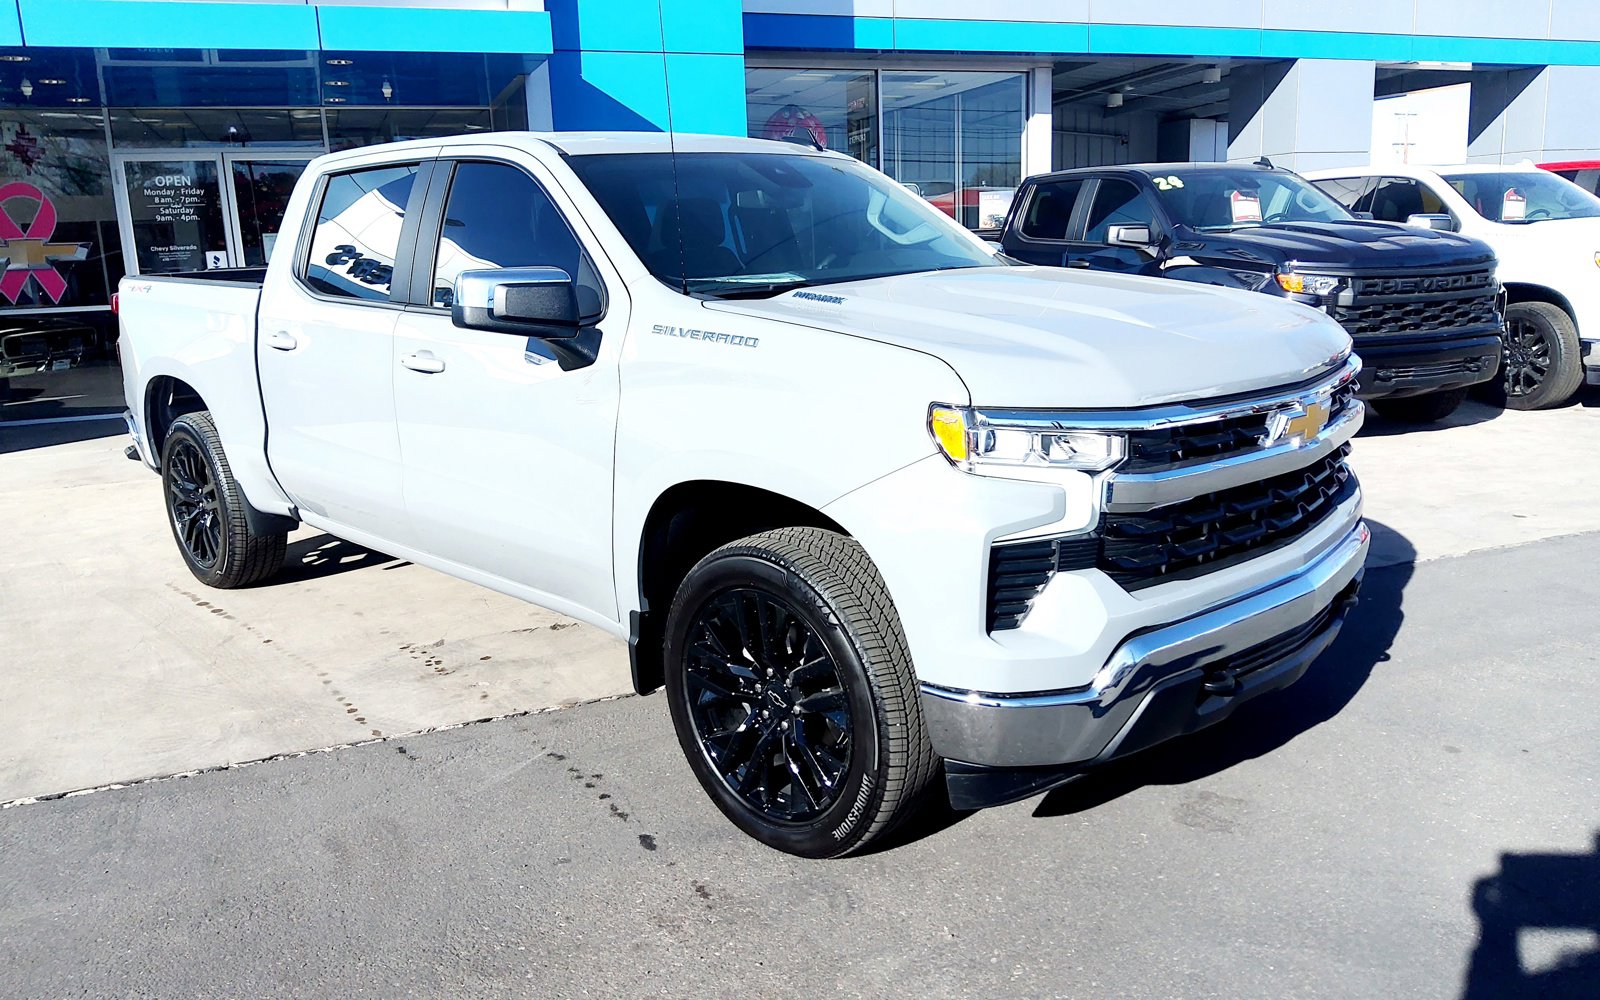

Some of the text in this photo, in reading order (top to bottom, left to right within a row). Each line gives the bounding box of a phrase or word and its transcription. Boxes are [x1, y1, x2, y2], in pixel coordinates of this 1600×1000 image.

[155, 175, 191, 187] OPEN
[144, 188, 175, 197] Monday
[181, 188, 205, 196] Friday
[160, 207, 194, 215] Saturday
[651, 324, 760, 348] SILVERADO
[831, 772, 876, 842] BRIDGESTONE
